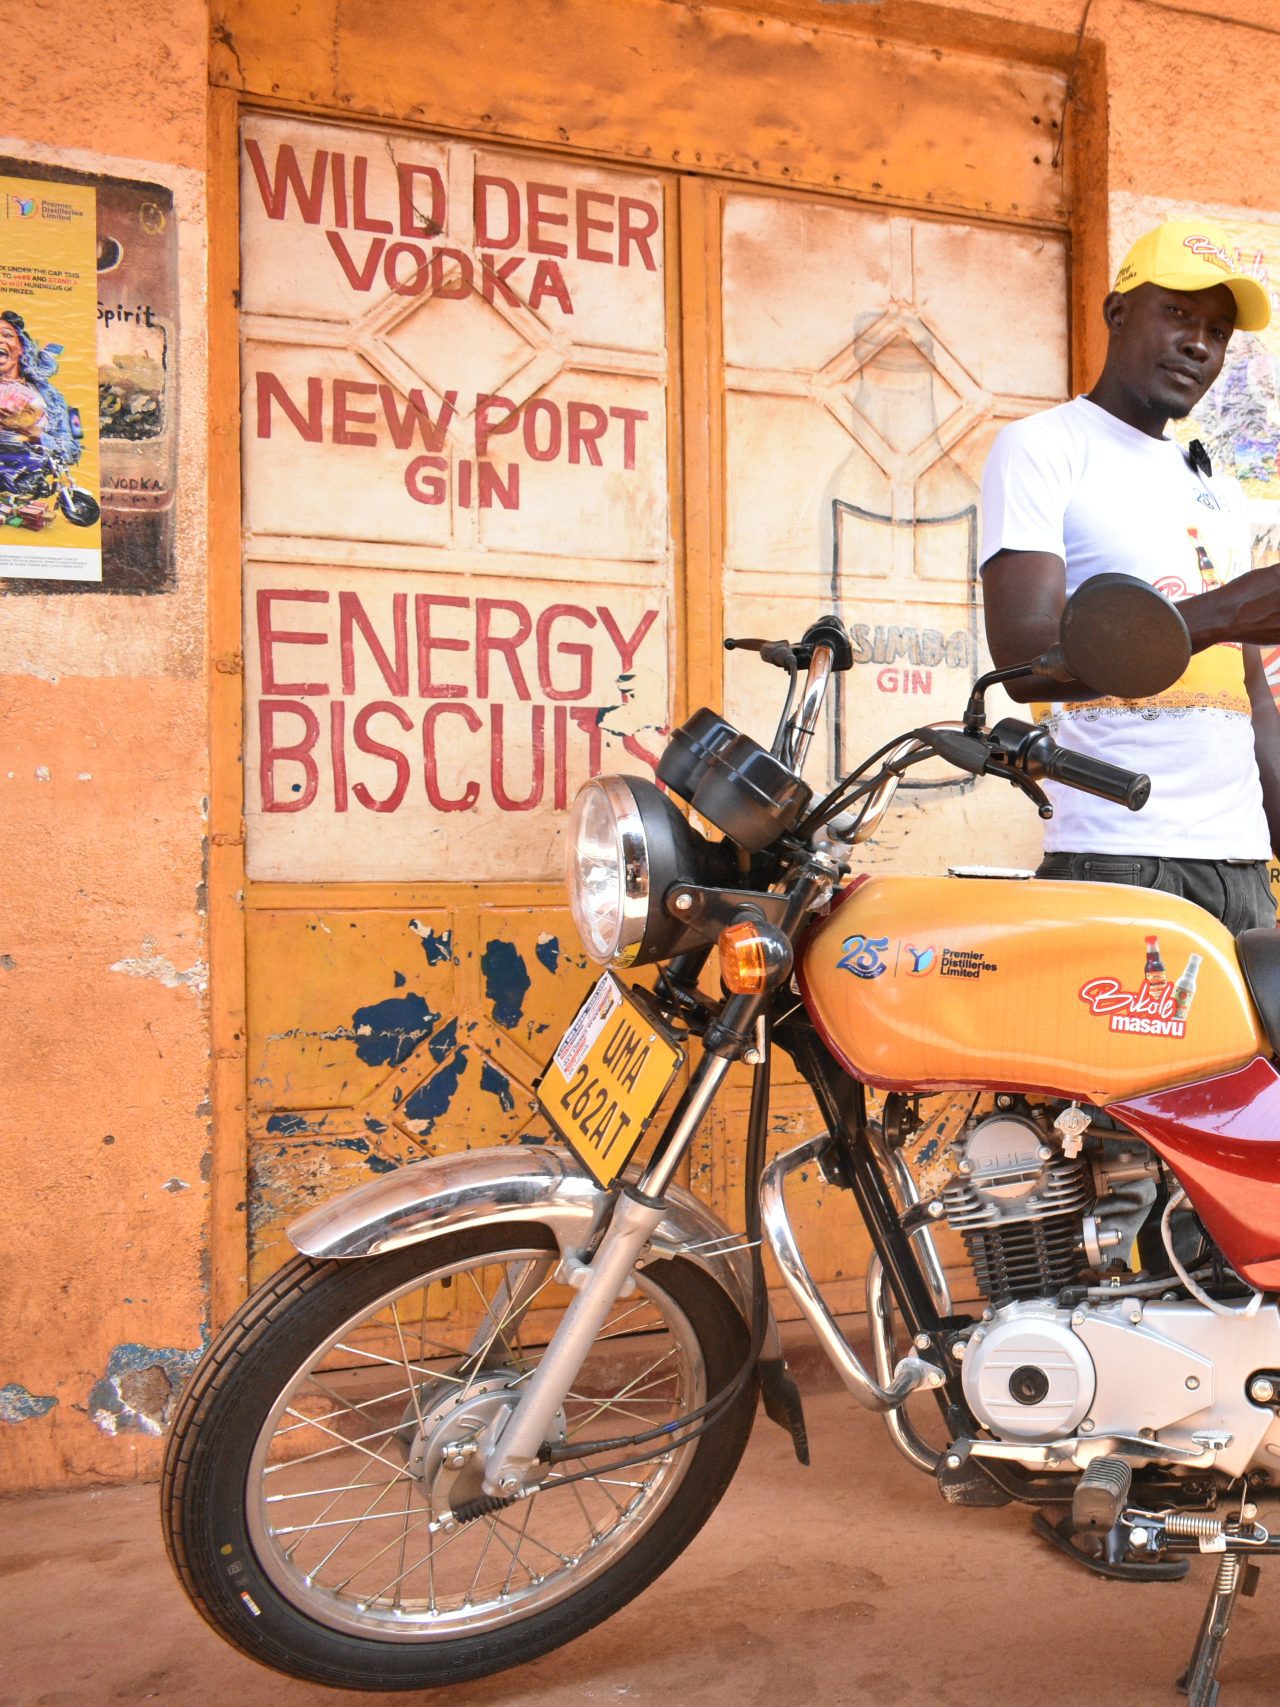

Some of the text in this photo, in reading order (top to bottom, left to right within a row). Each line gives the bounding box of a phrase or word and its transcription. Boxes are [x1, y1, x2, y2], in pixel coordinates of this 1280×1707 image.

[244, 138, 658, 272] WILD DEER
[325, 230, 575, 315] VODKA
[110, 477, 163, 490] VODKA
[404, 455, 520, 510] GIN
[256, 589, 659, 702] ENERGY
[850, 624, 969, 668] SIMBA
[877, 668, 932, 694] GIN
[836, 936, 889, 969] 25
[940, 966, 980, 979] Limited
[941, 957, 998, 972] Distilleries
[943, 949, 984, 961] Premier
[1081, 979, 1174, 1019] Bikole
[1111, 1015, 1184, 1037] masavu
[602, 1018, 652, 1094] UMA
[560, 1063, 632, 1160] 262AT
